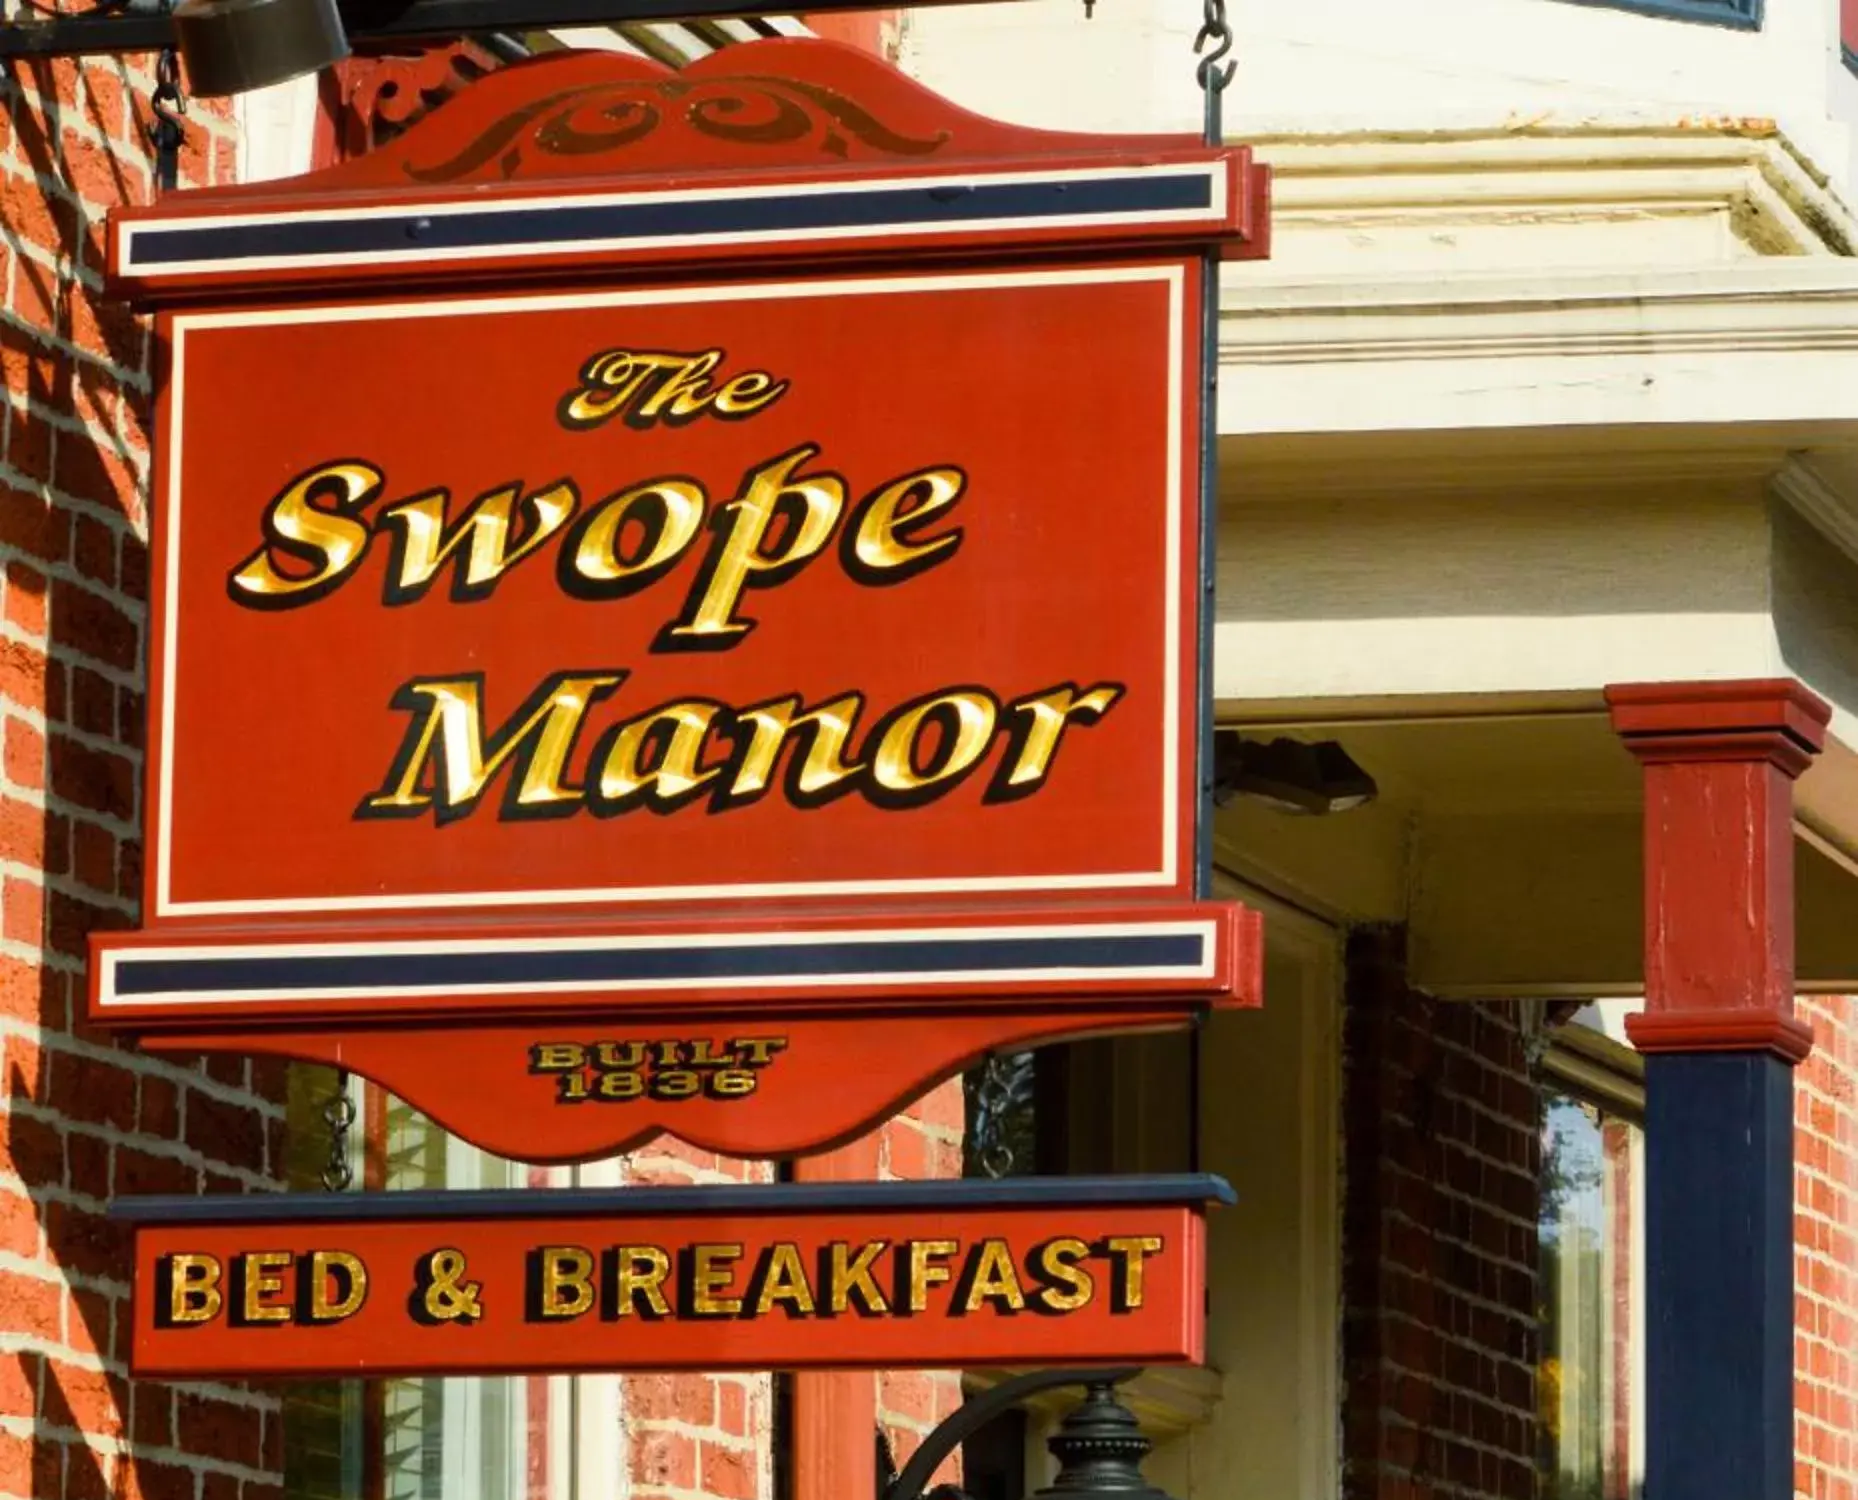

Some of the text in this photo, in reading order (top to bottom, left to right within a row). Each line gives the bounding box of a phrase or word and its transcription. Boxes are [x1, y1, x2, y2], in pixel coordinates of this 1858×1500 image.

[559, 348, 789, 429] The
[228, 442, 967, 650] Swope
[354, 670, 1125, 825] Manor
[530, 1036, 788, 1073] BUILT
[556, 1069, 757, 1104] 1836
[156, 1236, 1164, 1328] BED & BREAKFAST
